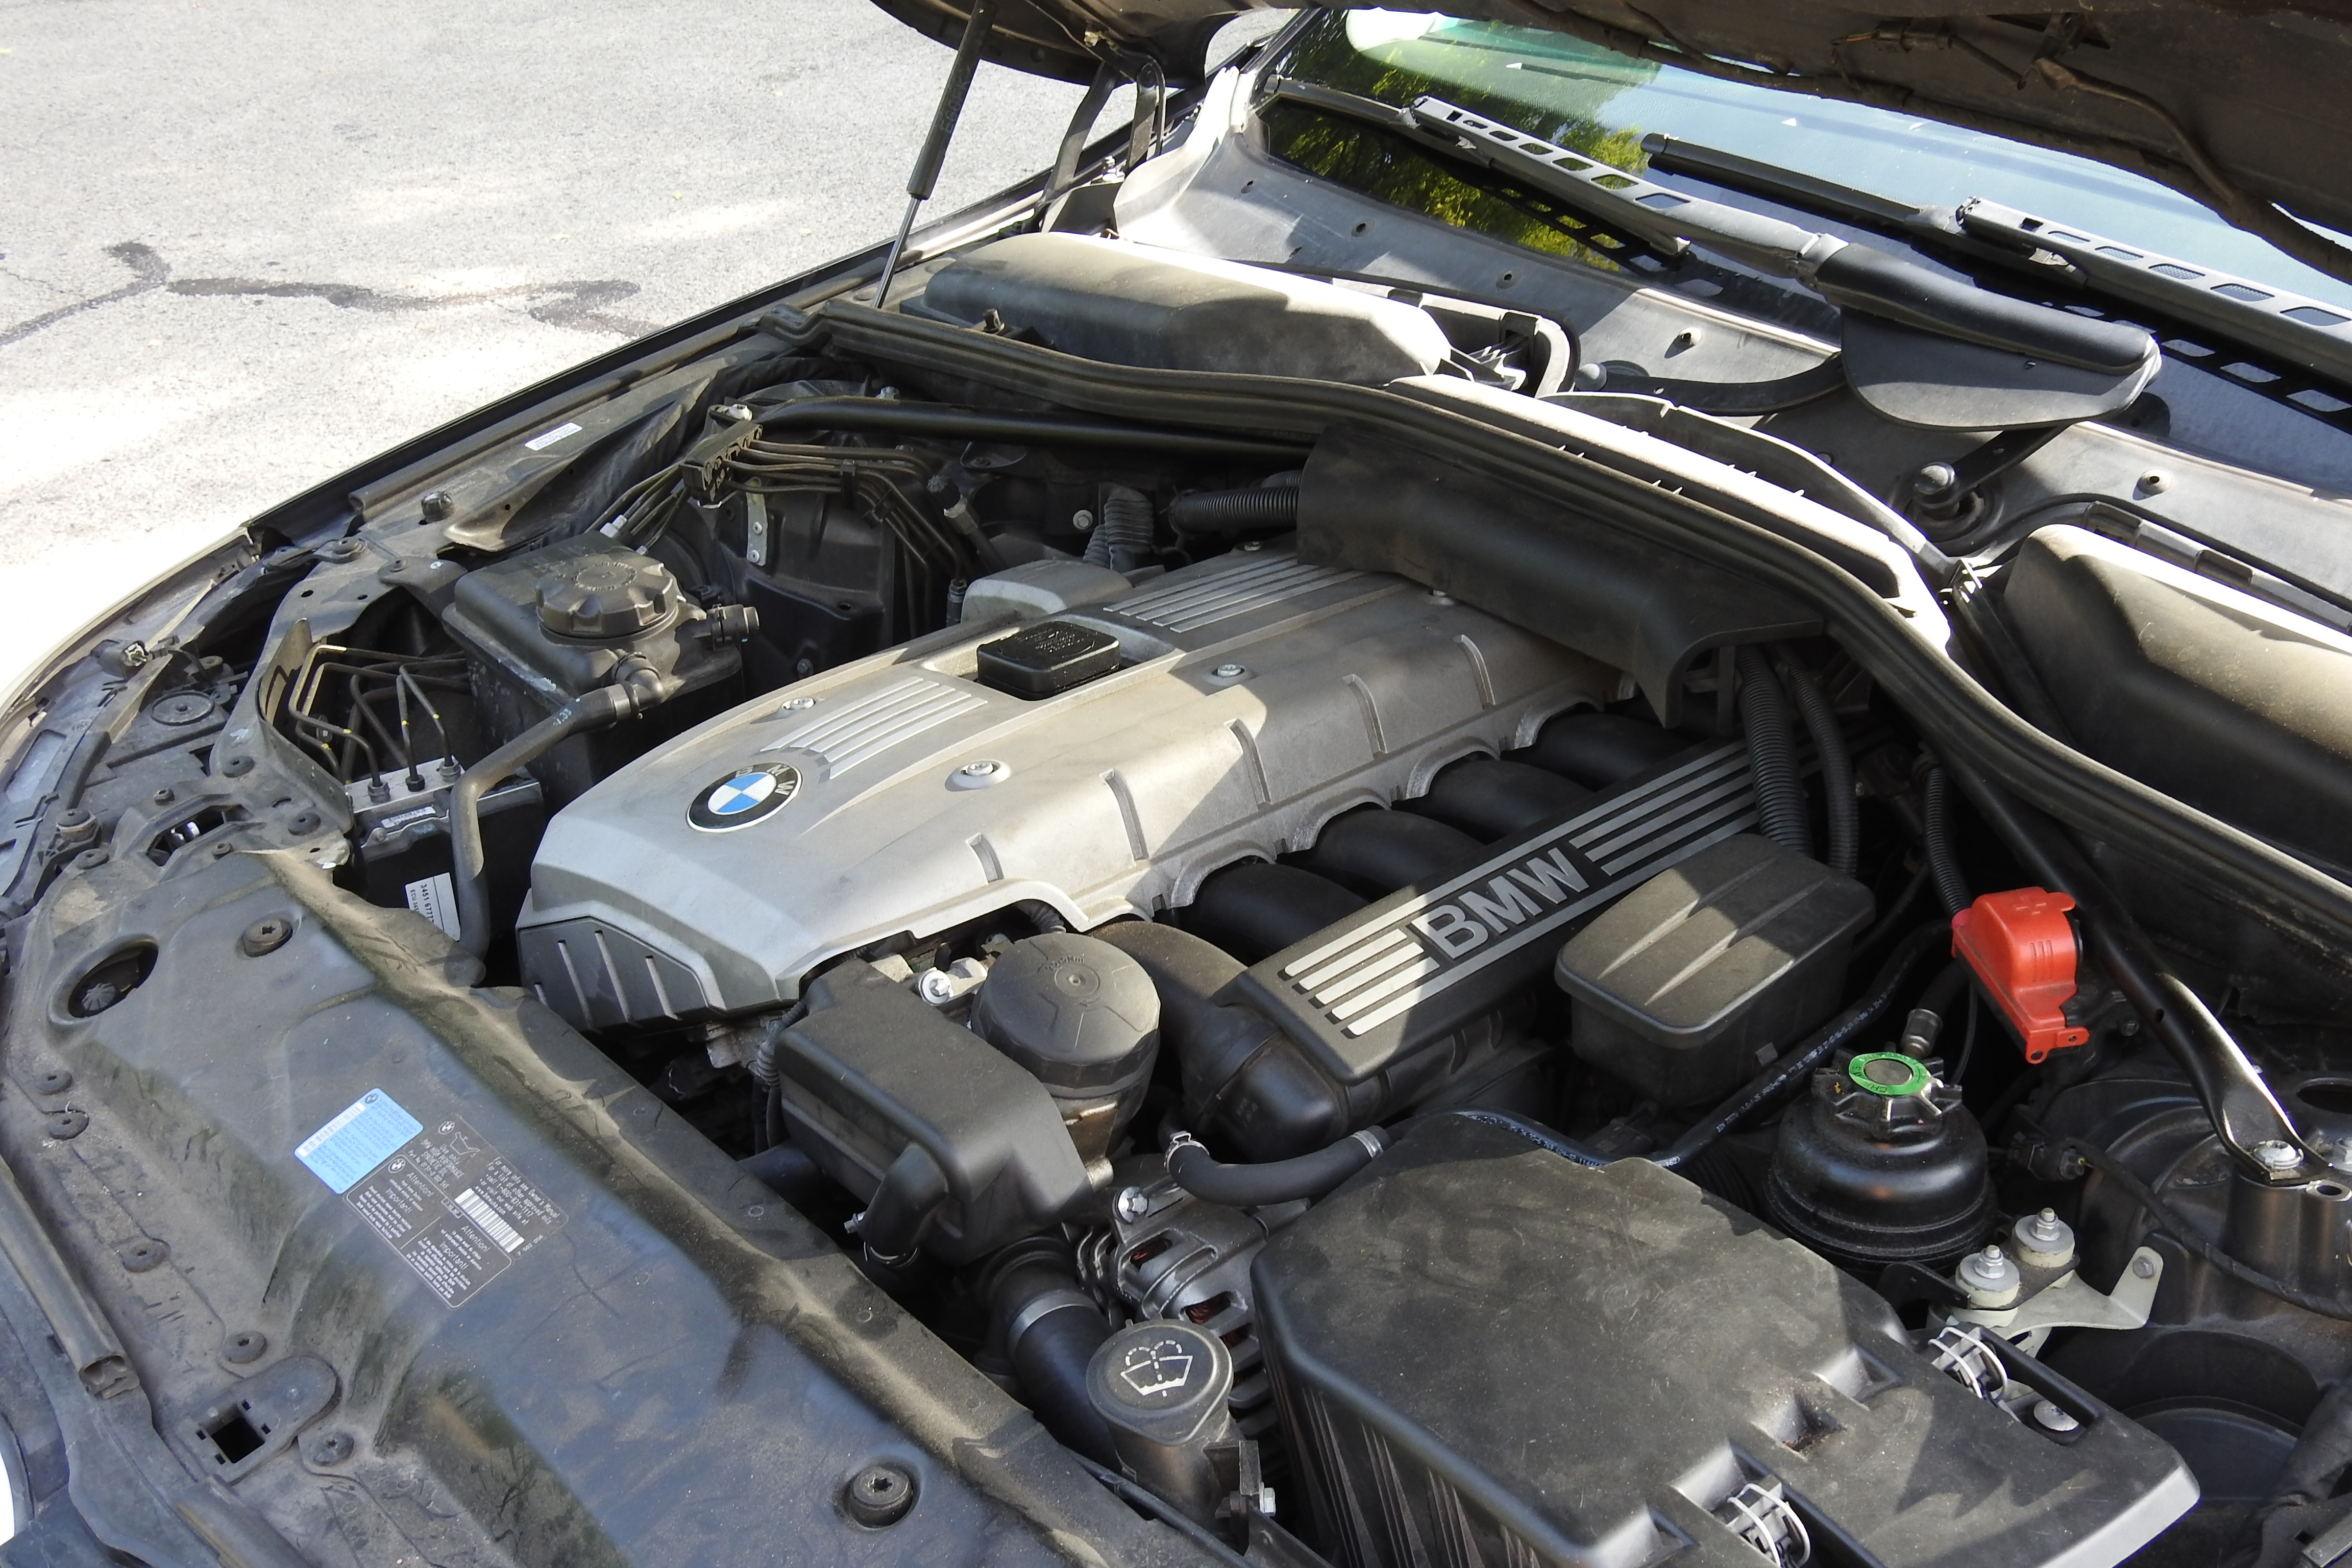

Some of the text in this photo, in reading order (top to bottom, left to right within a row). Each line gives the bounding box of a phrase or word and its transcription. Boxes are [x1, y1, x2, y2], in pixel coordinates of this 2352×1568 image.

[421, 884, 430, 901] 3451
[1411, 847, 1590, 960] BMW
[438, 1143, 463, 1165] Use only
[406, 1171, 435, 1197] Attention!
[384, 1188, 413, 1214] Important!
[543, 1203, 561, 1218] Manual
[460, 1224, 491, 1253] Attention!
[437, 1241, 470, 1270] Important!
